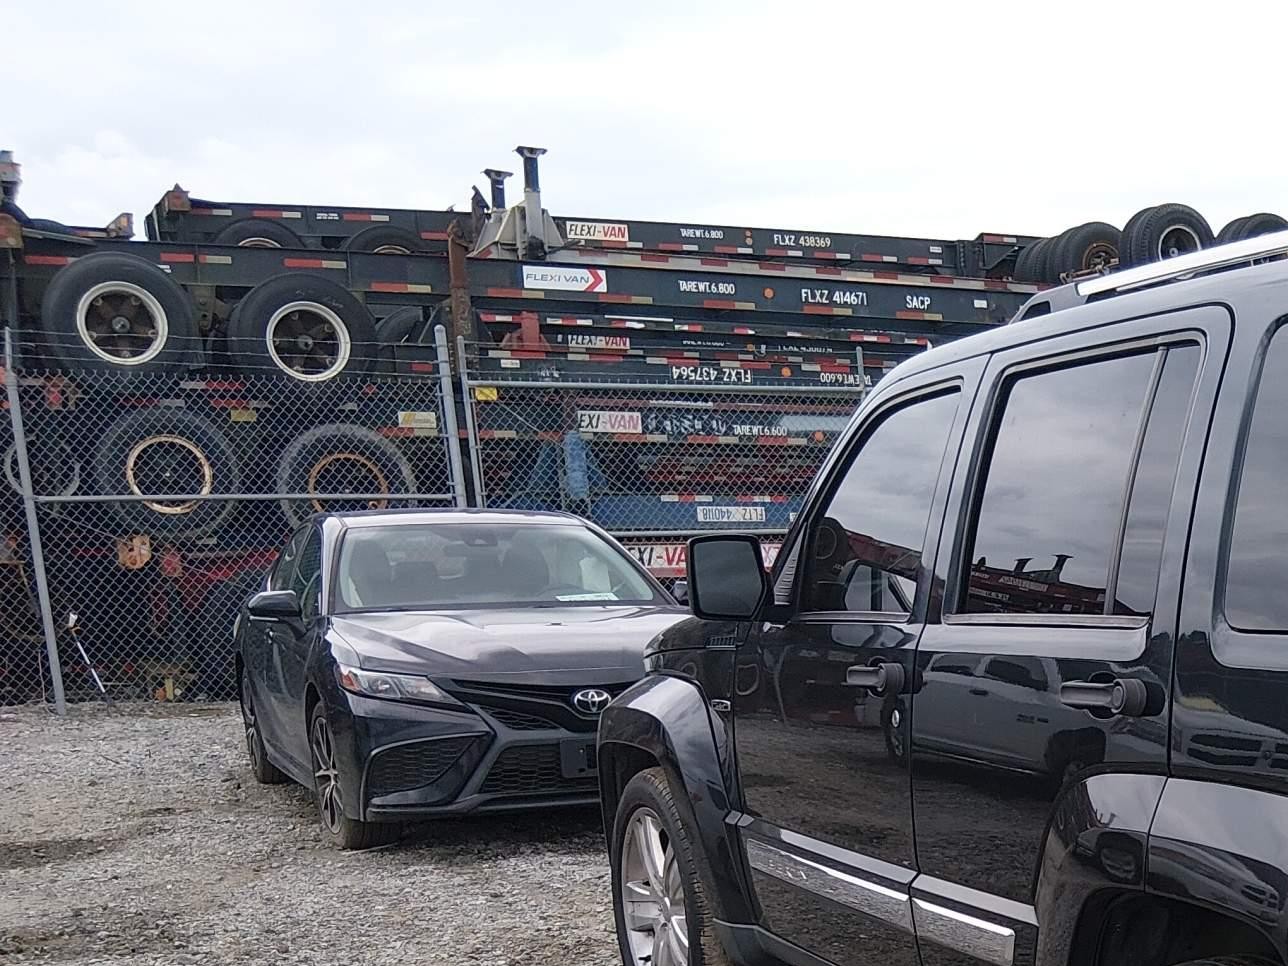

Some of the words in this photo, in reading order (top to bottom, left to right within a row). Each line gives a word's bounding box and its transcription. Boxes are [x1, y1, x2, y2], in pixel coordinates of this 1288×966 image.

[568, 223, 626, 239] FLEXI-VAN
[773, 234, 795, 246] FLXZ
[799, 235, 831, 248] 438369
[801, 288, 829, 304] FLXZ
[832, 290, 868, 306] 414671
[905, 296, 931, 309] SACP
[672, 366, 717, 381] 437564
[722, 368, 752, 383] FLXZ
